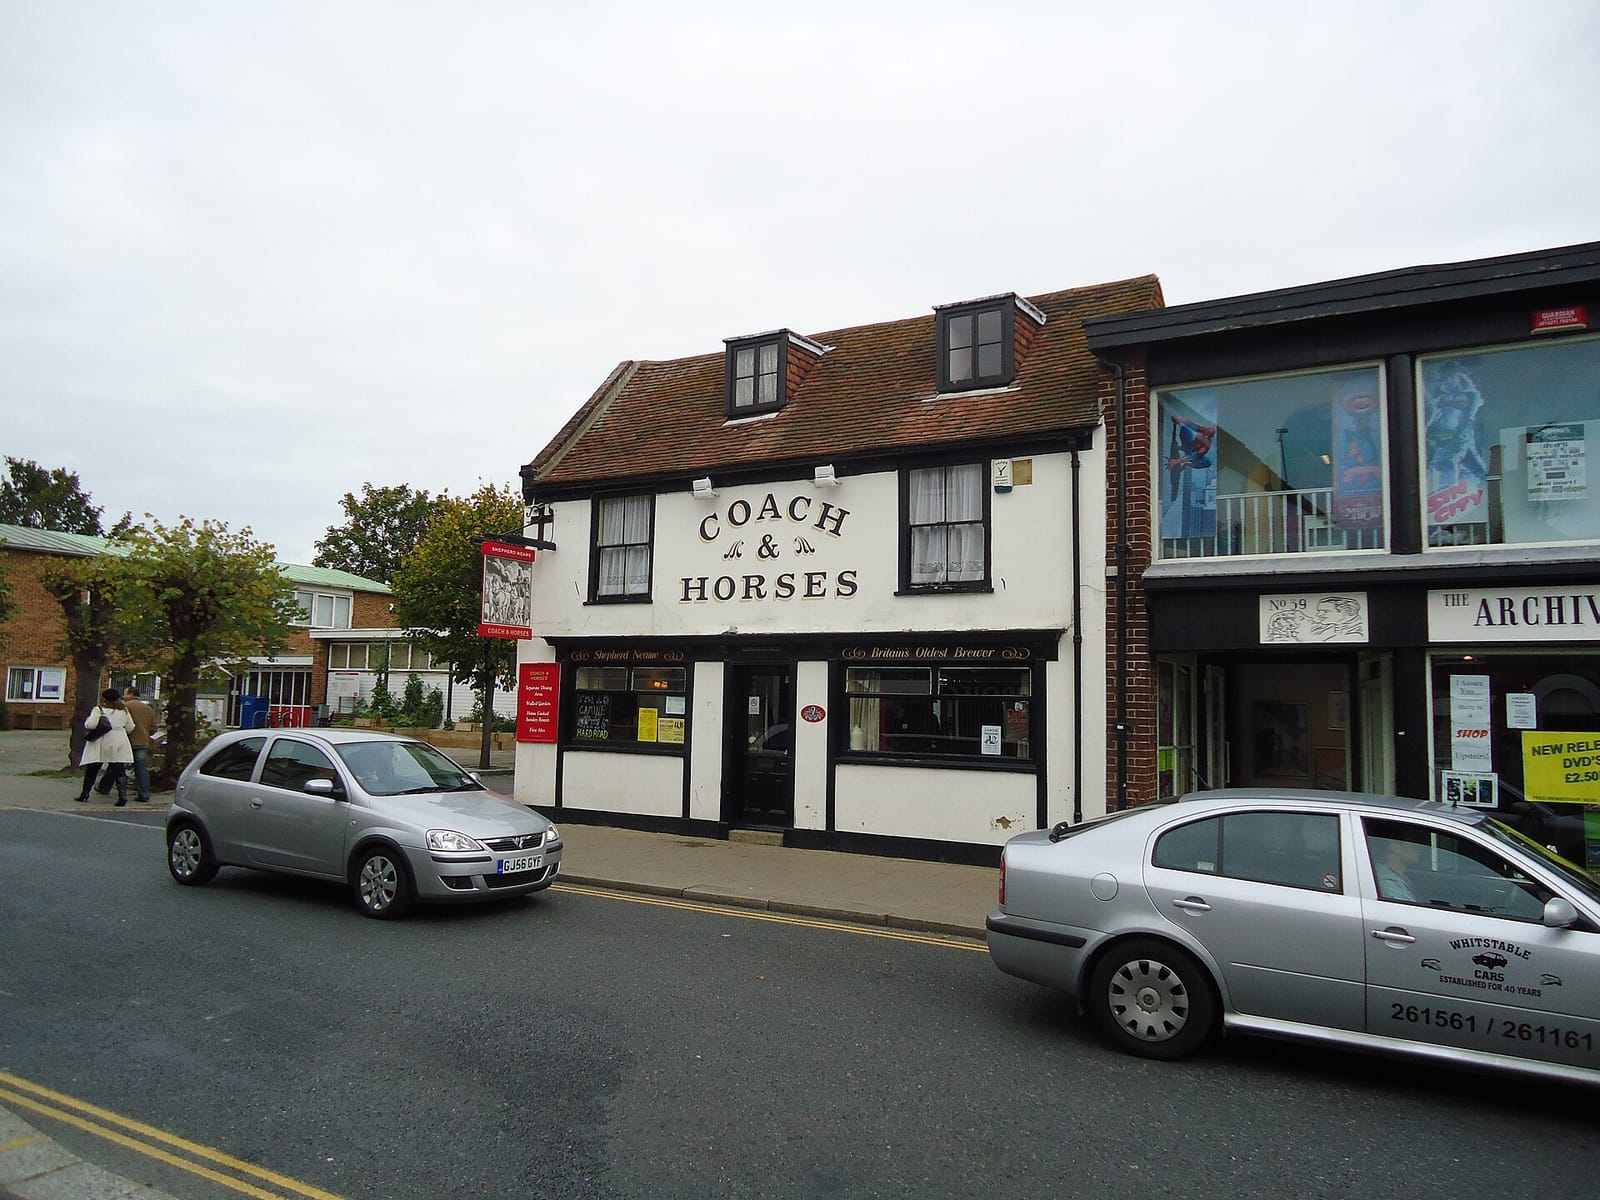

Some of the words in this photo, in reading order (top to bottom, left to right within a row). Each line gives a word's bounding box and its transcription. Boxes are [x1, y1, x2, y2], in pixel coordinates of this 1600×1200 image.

[1435, 487, 1483, 523] CITY
[699, 493, 851, 541] COACH
[491, 546, 516, 555] SHEPHERD
[757, 534, 780, 559] &
[680, 570, 859, 602] HORSES
[1443, 593, 1469, 607] THE
[487, 627, 505, 635] COACH
[510, 629, 529, 637] HORSES
[593, 650, 630, 661] Shepherd
[871, 647, 910, 658] Britain's
[915, 646, 948, 658] Oldest
[953, 646, 996, 658] Brewer
[1456, 729, 1489, 738] SHOP
[1531, 743, 1563, 756] NEW
[1565, 771, 1599, 783] £2.50
[503, 859, 526, 872] GJ56
[527, 855, 542, 868] GYF
[1449, 937, 1532, 961] WHITSTABLE
[1474, 969, 1505, 982] CARS
[1439, 975, 1487, 989] ESTABLISHED
[1487, 981, 1502, 991] FOR
[1504, 984, 1515, 993] 40
[1517, 986, 1542, 997] YEARS
[1391, 1003, 1476, 1033] 261561
[1502, 1020, 1593, 1051] 261161
